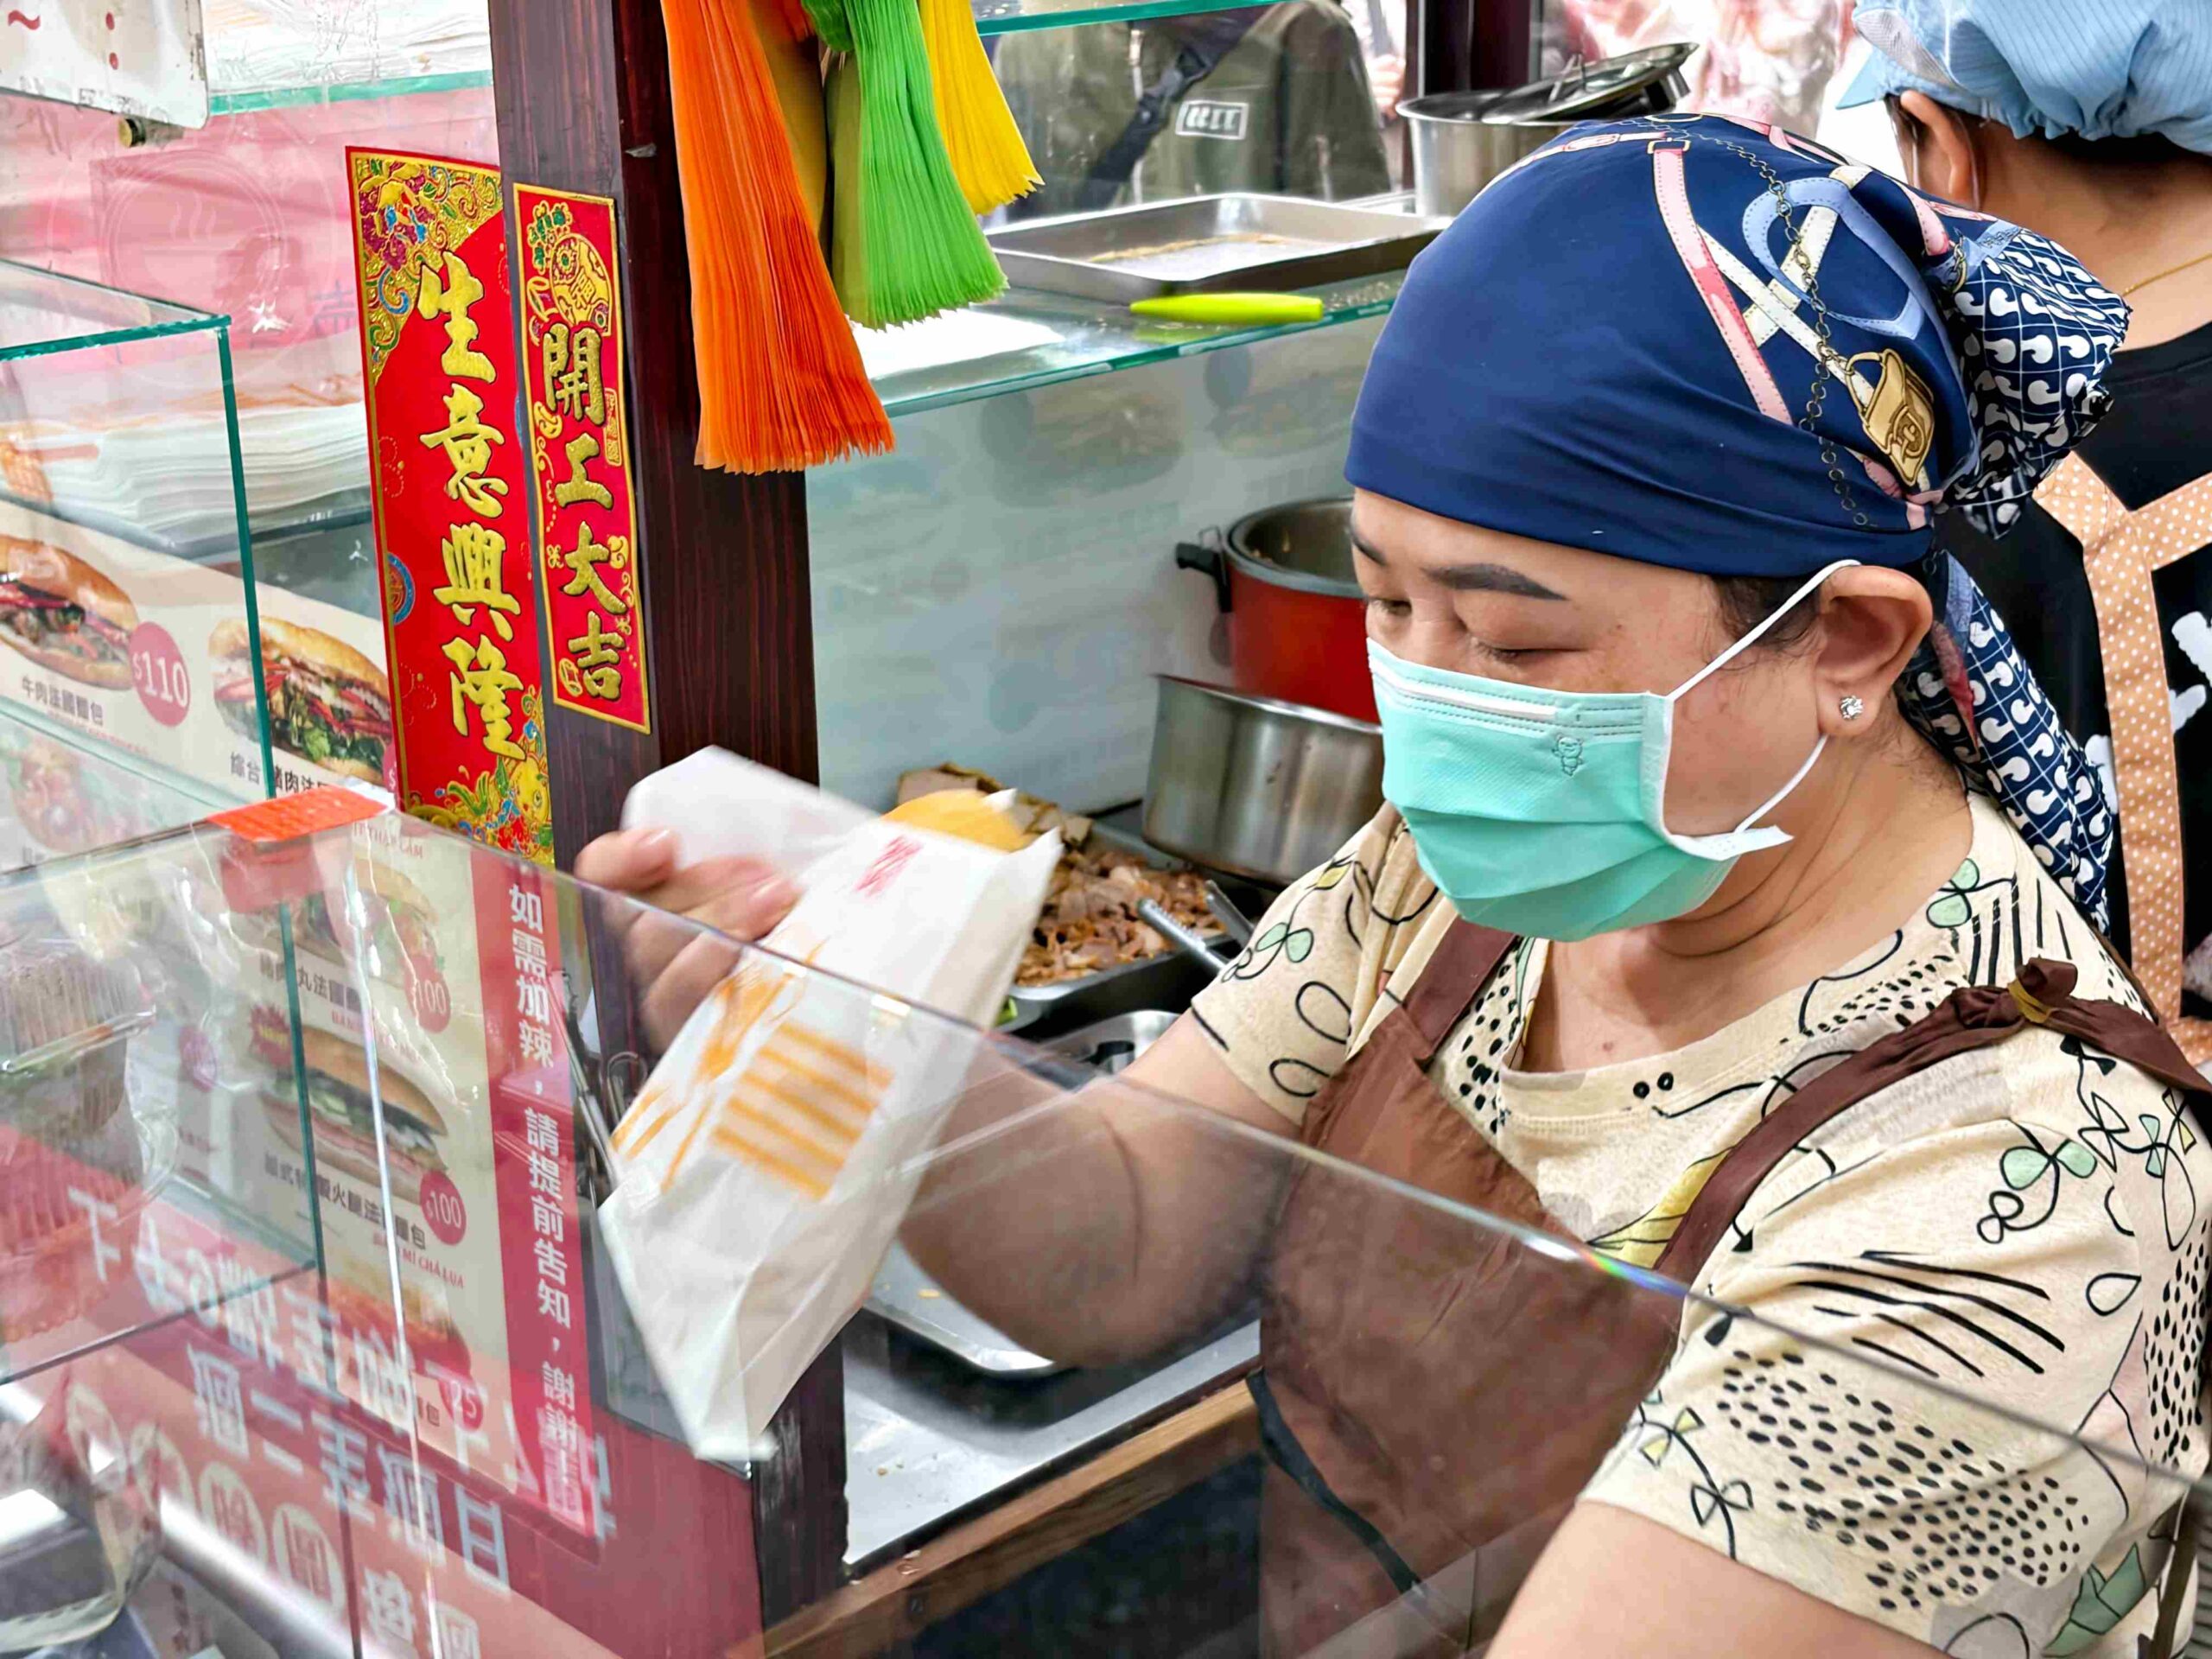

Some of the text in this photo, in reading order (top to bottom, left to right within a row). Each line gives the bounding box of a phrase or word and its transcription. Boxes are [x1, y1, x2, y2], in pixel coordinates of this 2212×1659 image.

[418, 249, 525, 760] 生意興隆
[542, 322, 625, 701] 開工大吉
[132, 650, 188, 708] $110
[425, 1189, 462, 1229] $100
